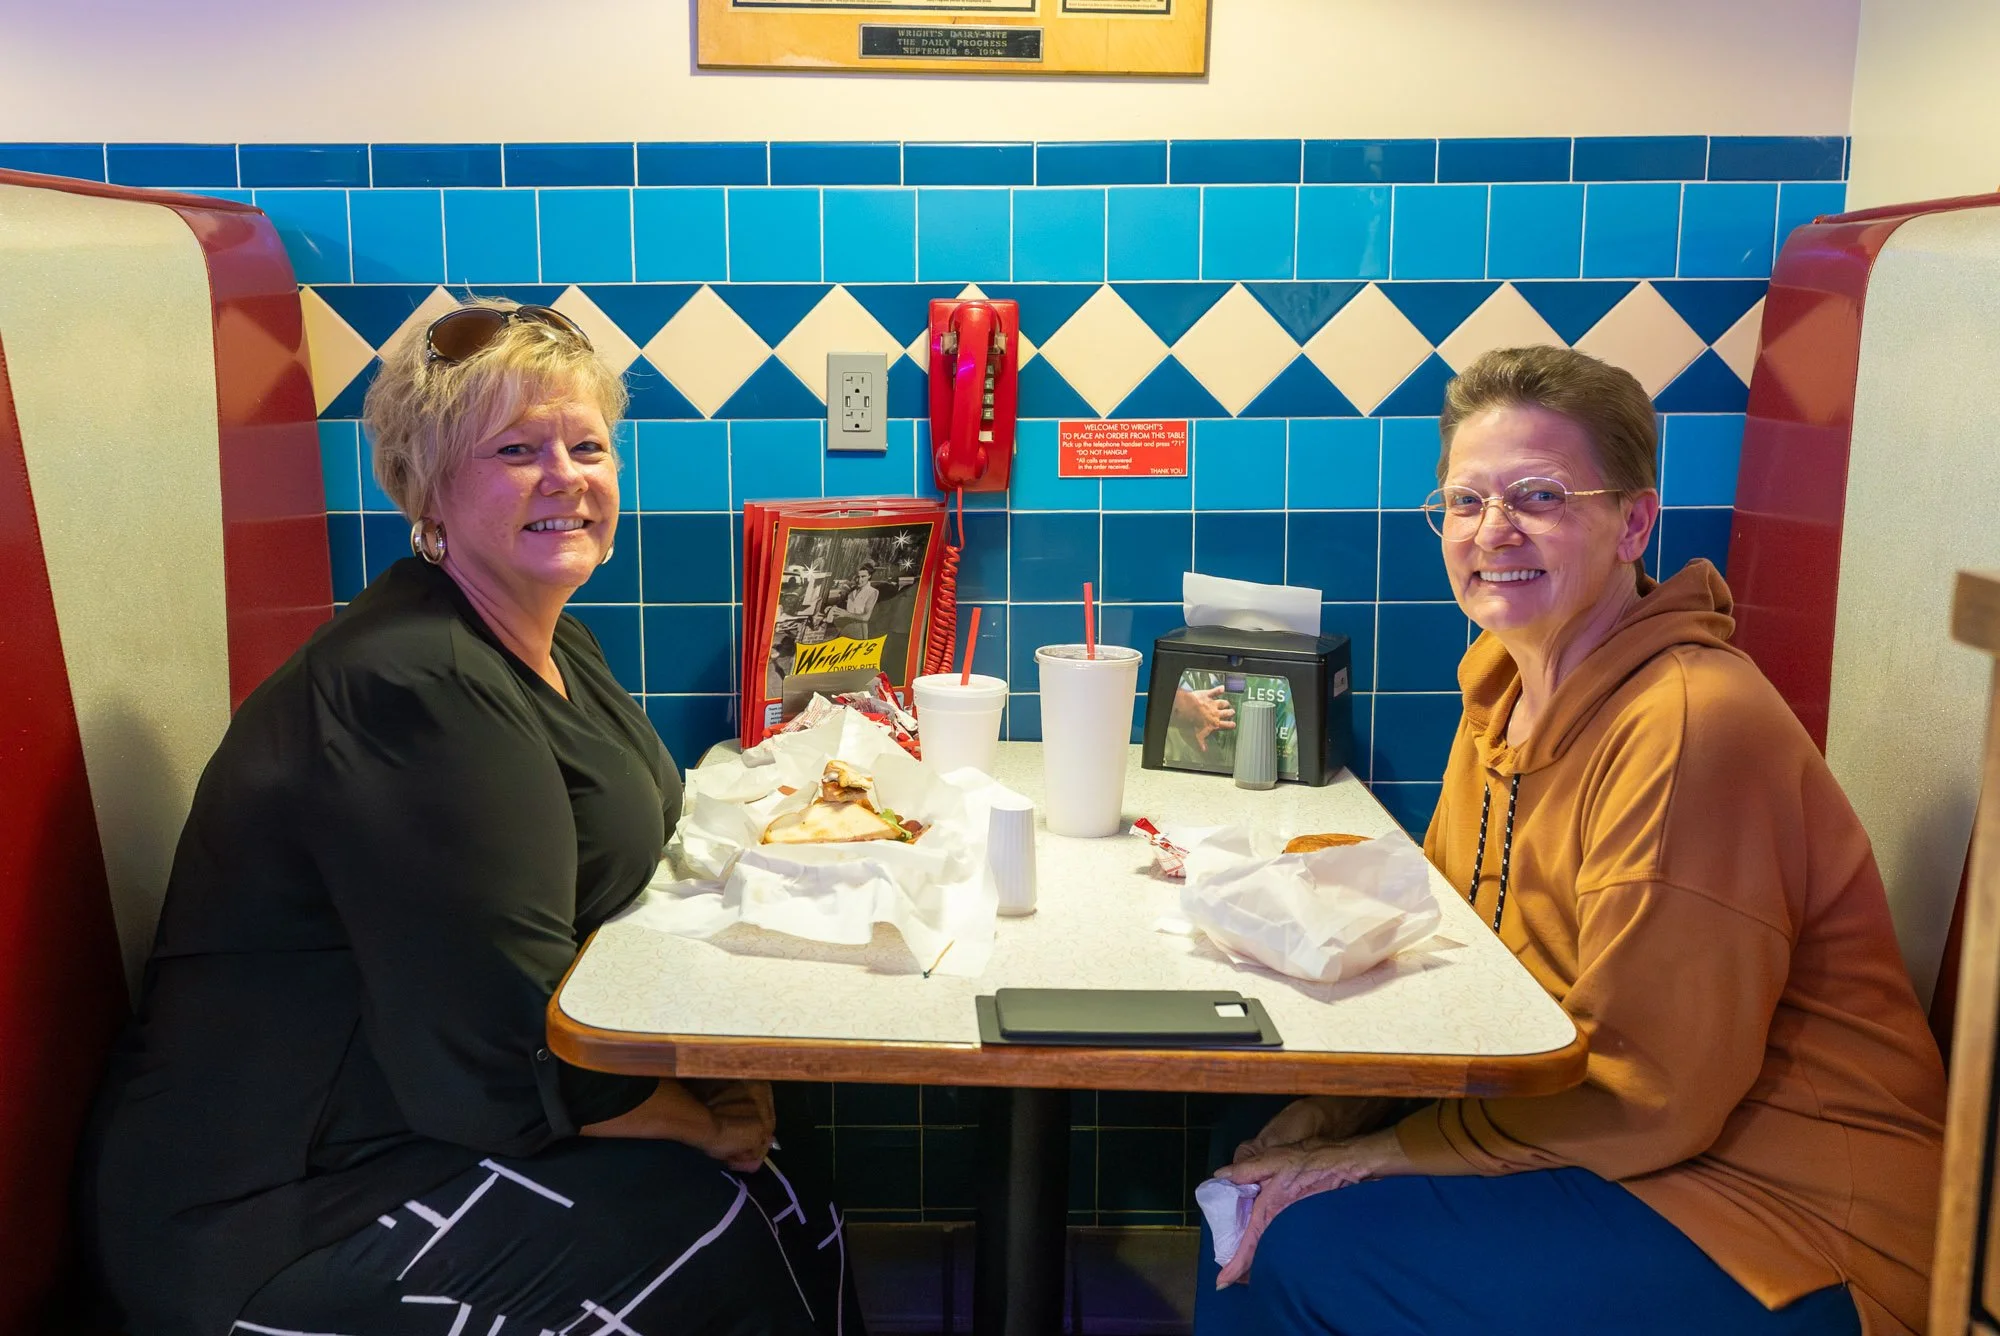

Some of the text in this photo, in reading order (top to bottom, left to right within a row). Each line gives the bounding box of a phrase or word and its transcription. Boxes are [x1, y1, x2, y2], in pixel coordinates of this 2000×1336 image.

[897, 29, 944, 38] WRIGHT'S
[897, 38, 1008, 48] THE DAILY PROGRESS
[902, 46, 958, 55] SEPTEMBER
[1062, 432, 1072, 440] TO
[1073, 432, 1093, 440] PLACE
[1094, 432, 1105, 440] AN
[1106, 432, 1129, 440] ORDER
[1130, 432, 1150, 440] FROM
[1166, 431, 1185, 439] TABLE
[1092, 441, 1120, 449] telephone
[1121, 440, 1142, 448] handset
[1155, 441, 1170, 449] press
[1150, 467, 1183, 475] THANK YOU
[795, 642, 877, 675] Wright's
[1247, 686, 1286, 702] LESS
